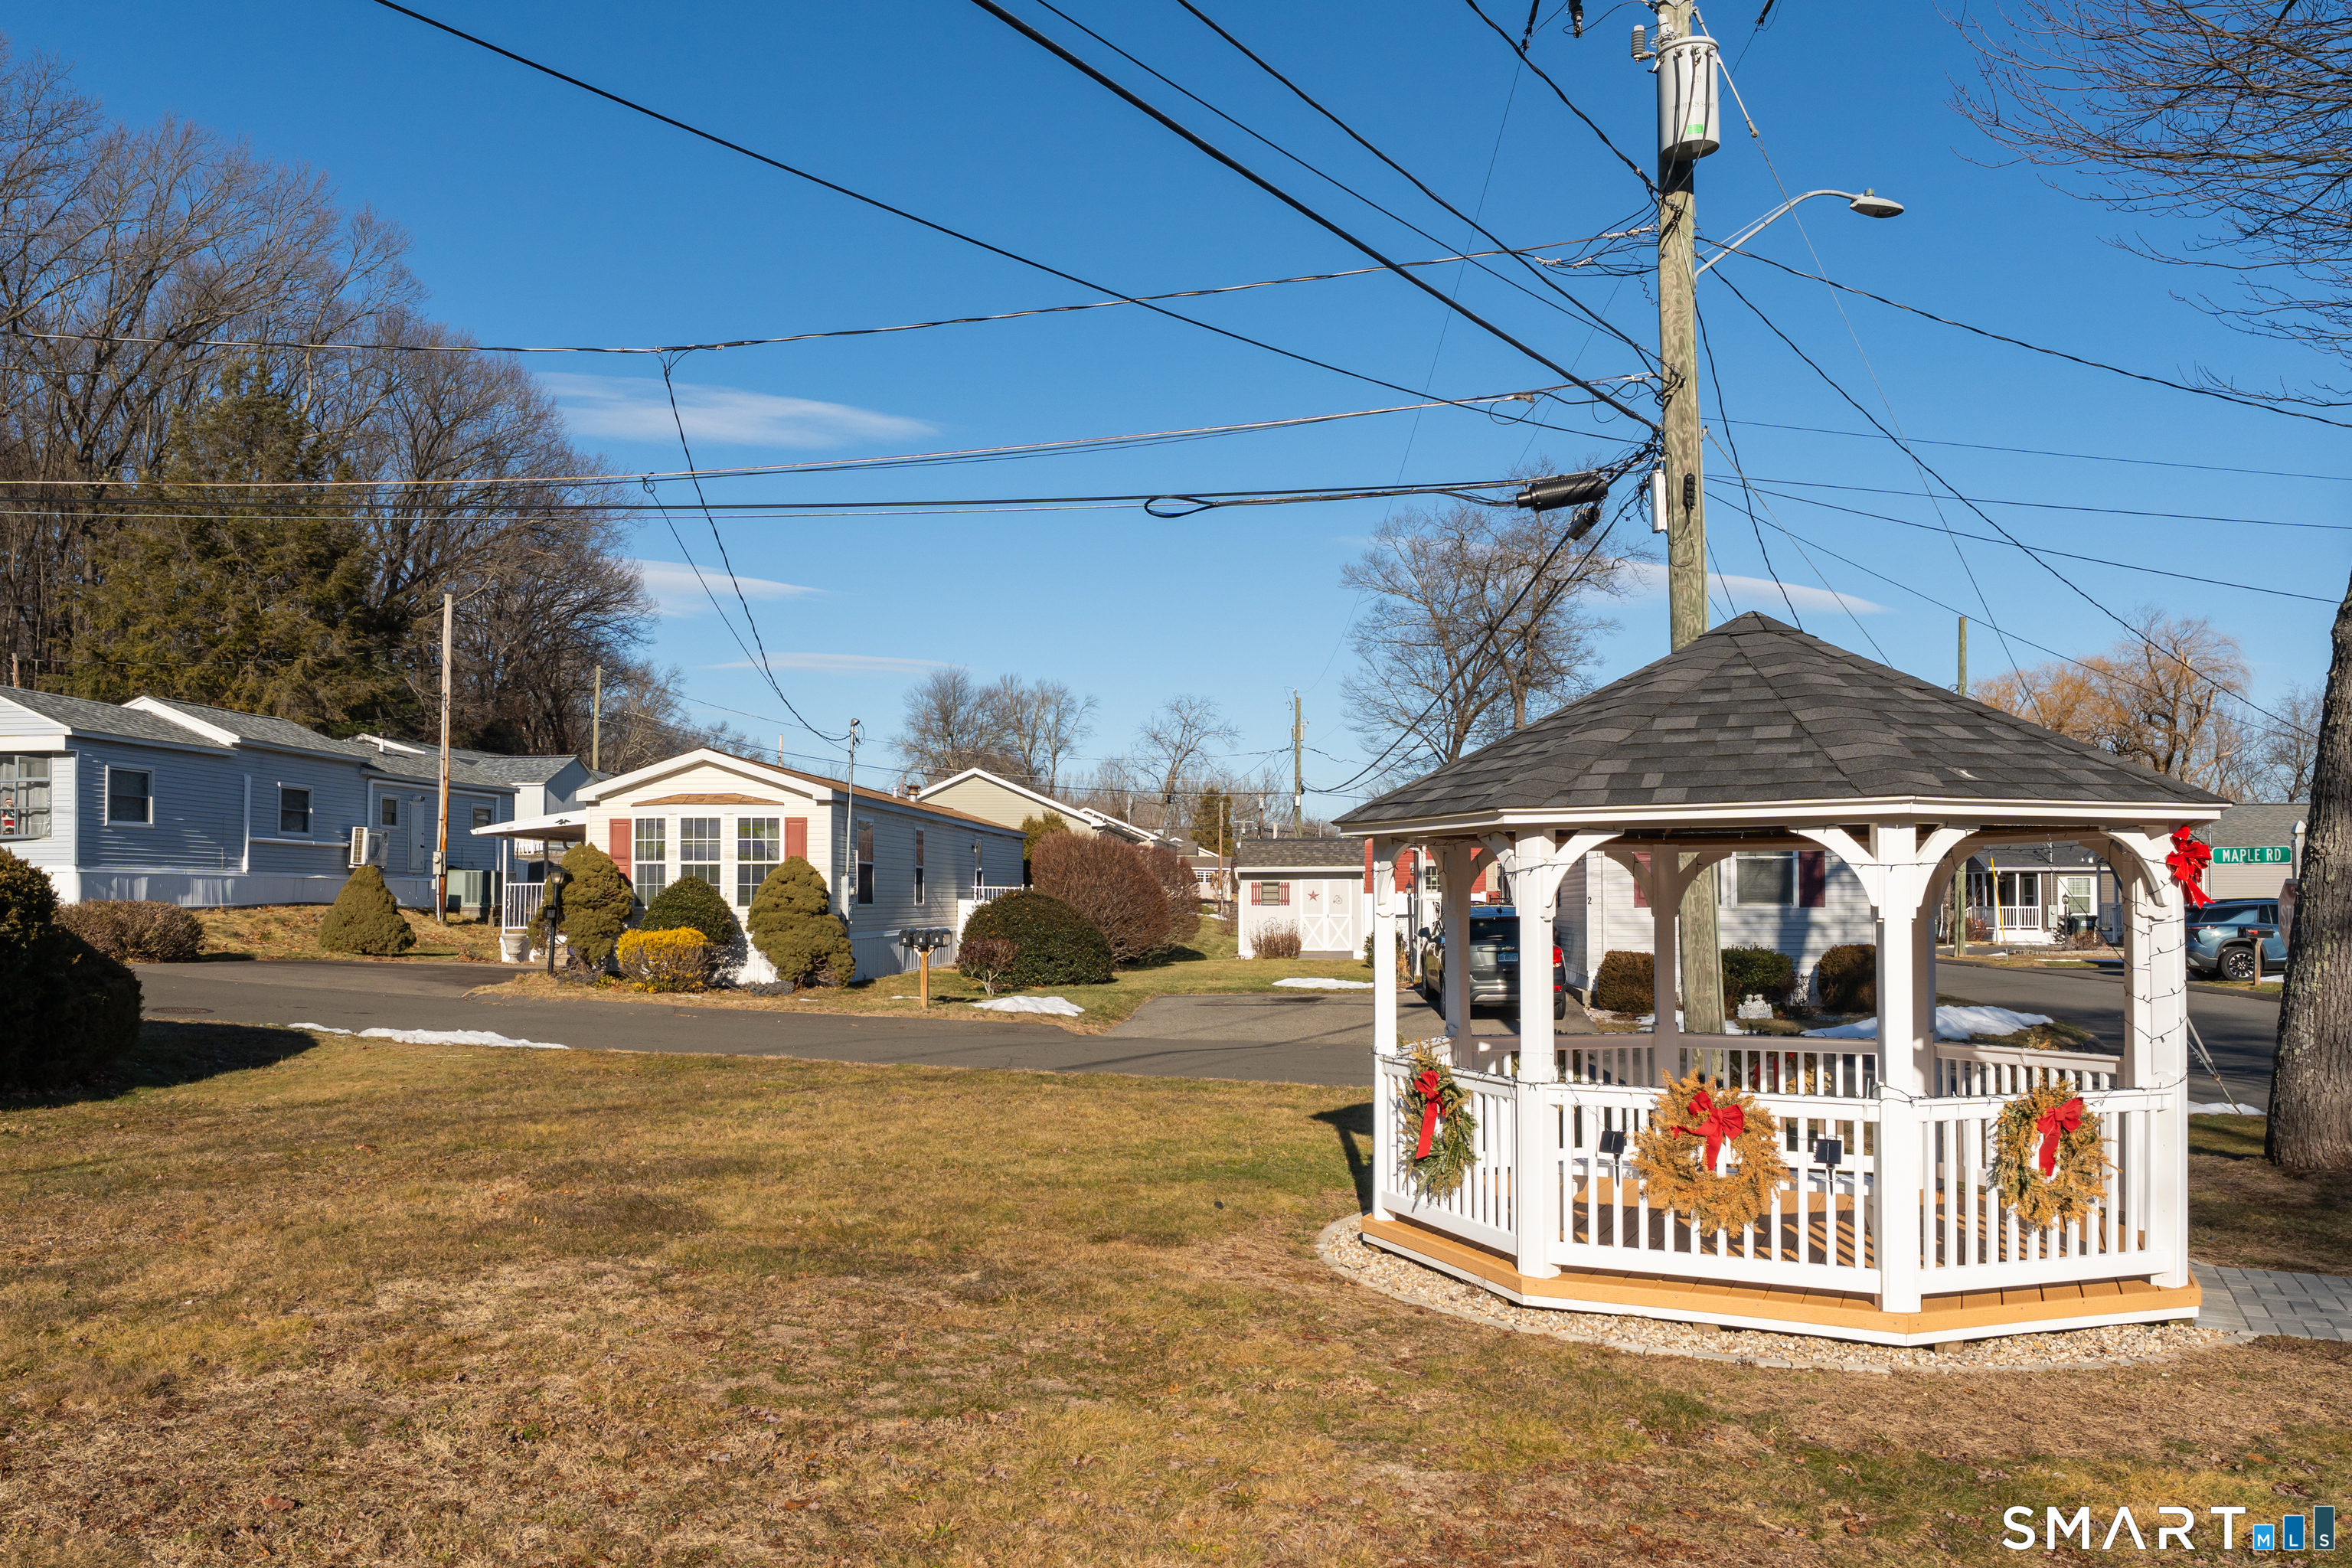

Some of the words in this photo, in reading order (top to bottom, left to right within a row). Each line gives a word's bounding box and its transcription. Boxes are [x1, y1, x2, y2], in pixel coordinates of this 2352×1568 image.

[2223, 849, 2261, 862] MAPLE
[2266, 848, 2282, 861] RD
[1587, 896, 1592, 905] 2
[2281, 904, 2295, 929] ST
